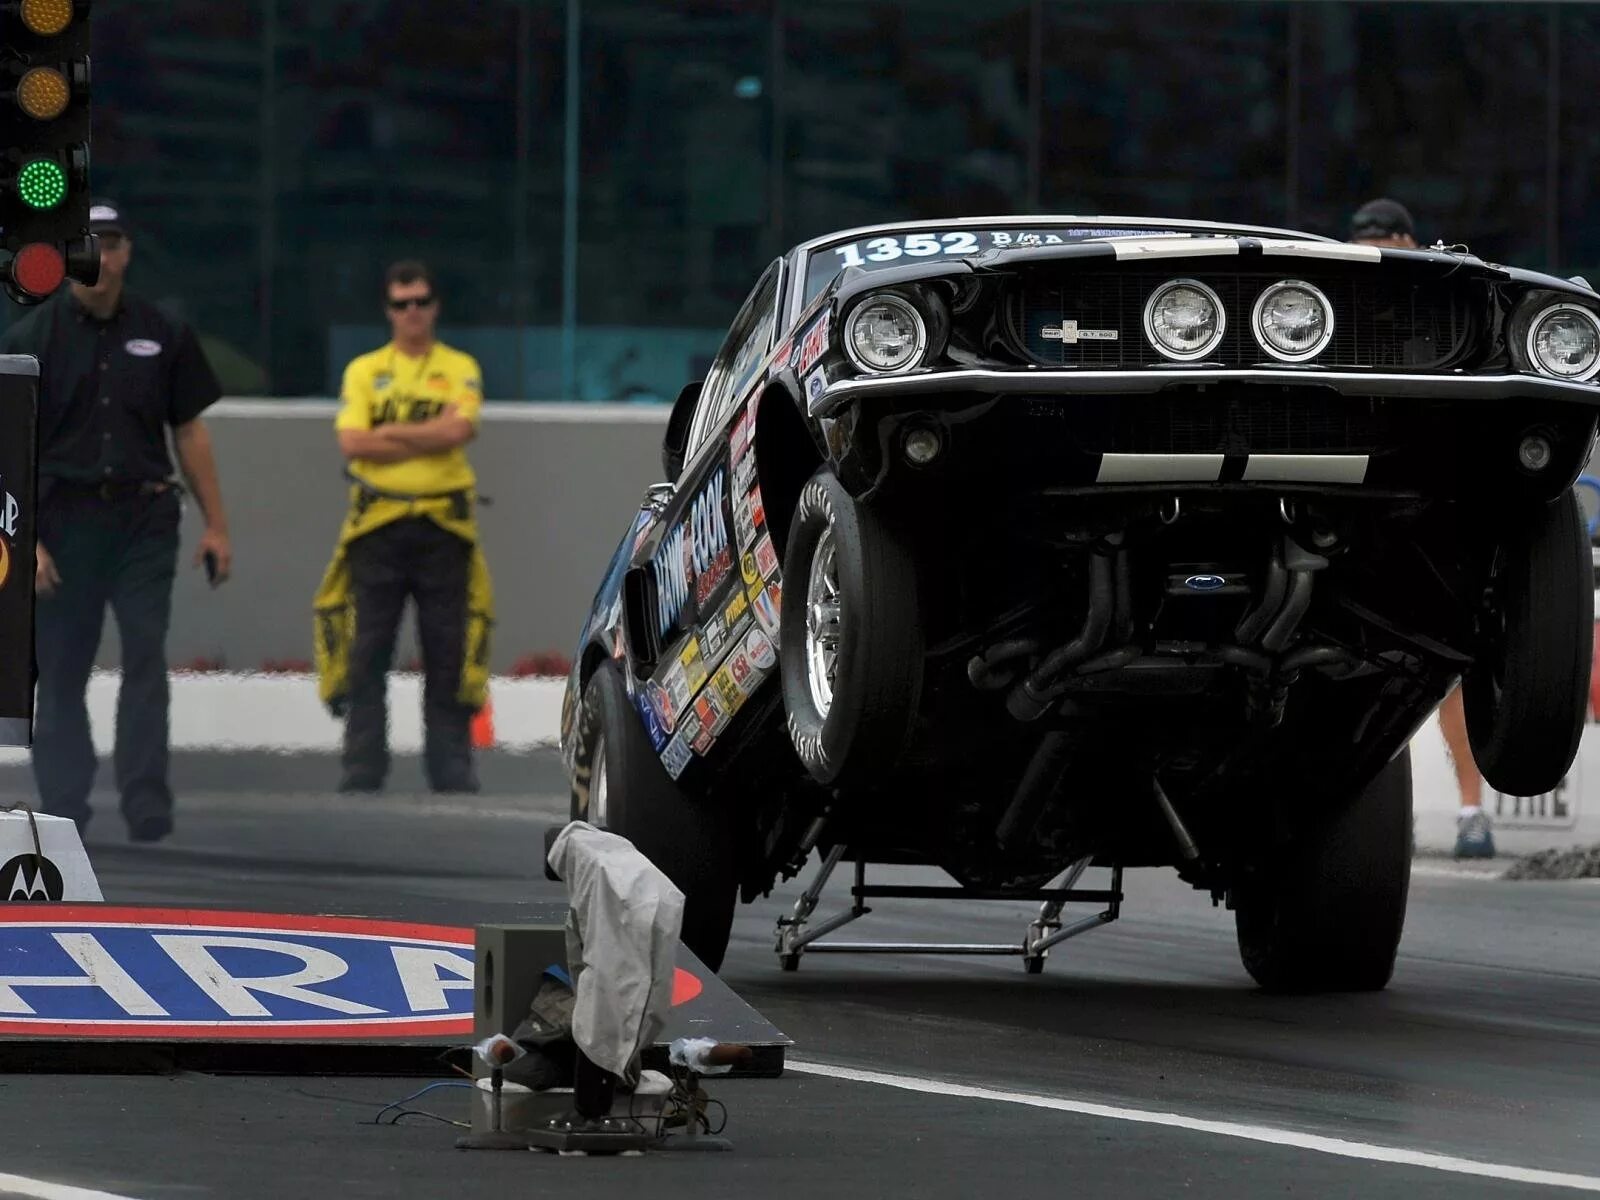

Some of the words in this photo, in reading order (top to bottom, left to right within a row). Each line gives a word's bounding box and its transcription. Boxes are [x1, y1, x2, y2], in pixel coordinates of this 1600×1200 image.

[834, 231, 981, 269] 1352
[691, 468, 728, 577] COOK
[730, 653, 752, 686] CSR
